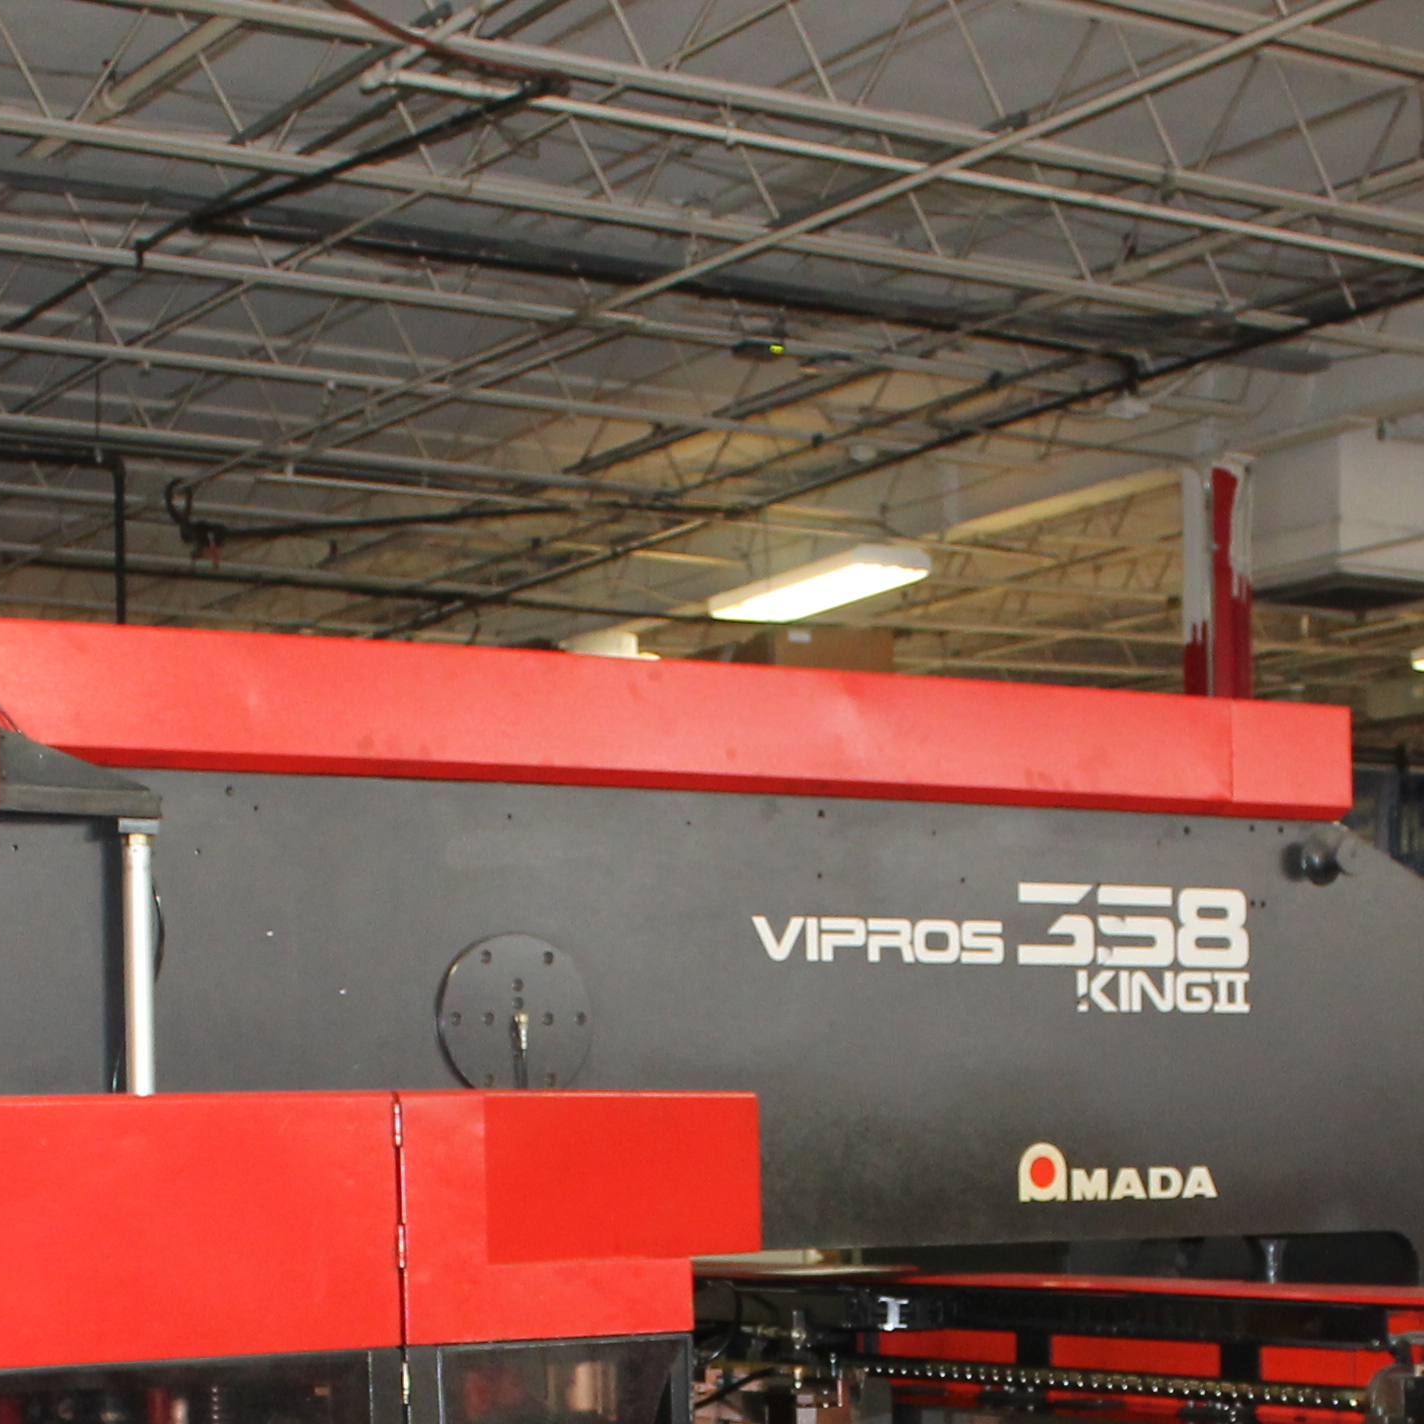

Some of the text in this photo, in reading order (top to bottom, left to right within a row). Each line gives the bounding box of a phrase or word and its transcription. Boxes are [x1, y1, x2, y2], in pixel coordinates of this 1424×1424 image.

[752, 882, 1250, 968] VIPROS 358
[1018, 1142, 1218, 1203] AMADA
